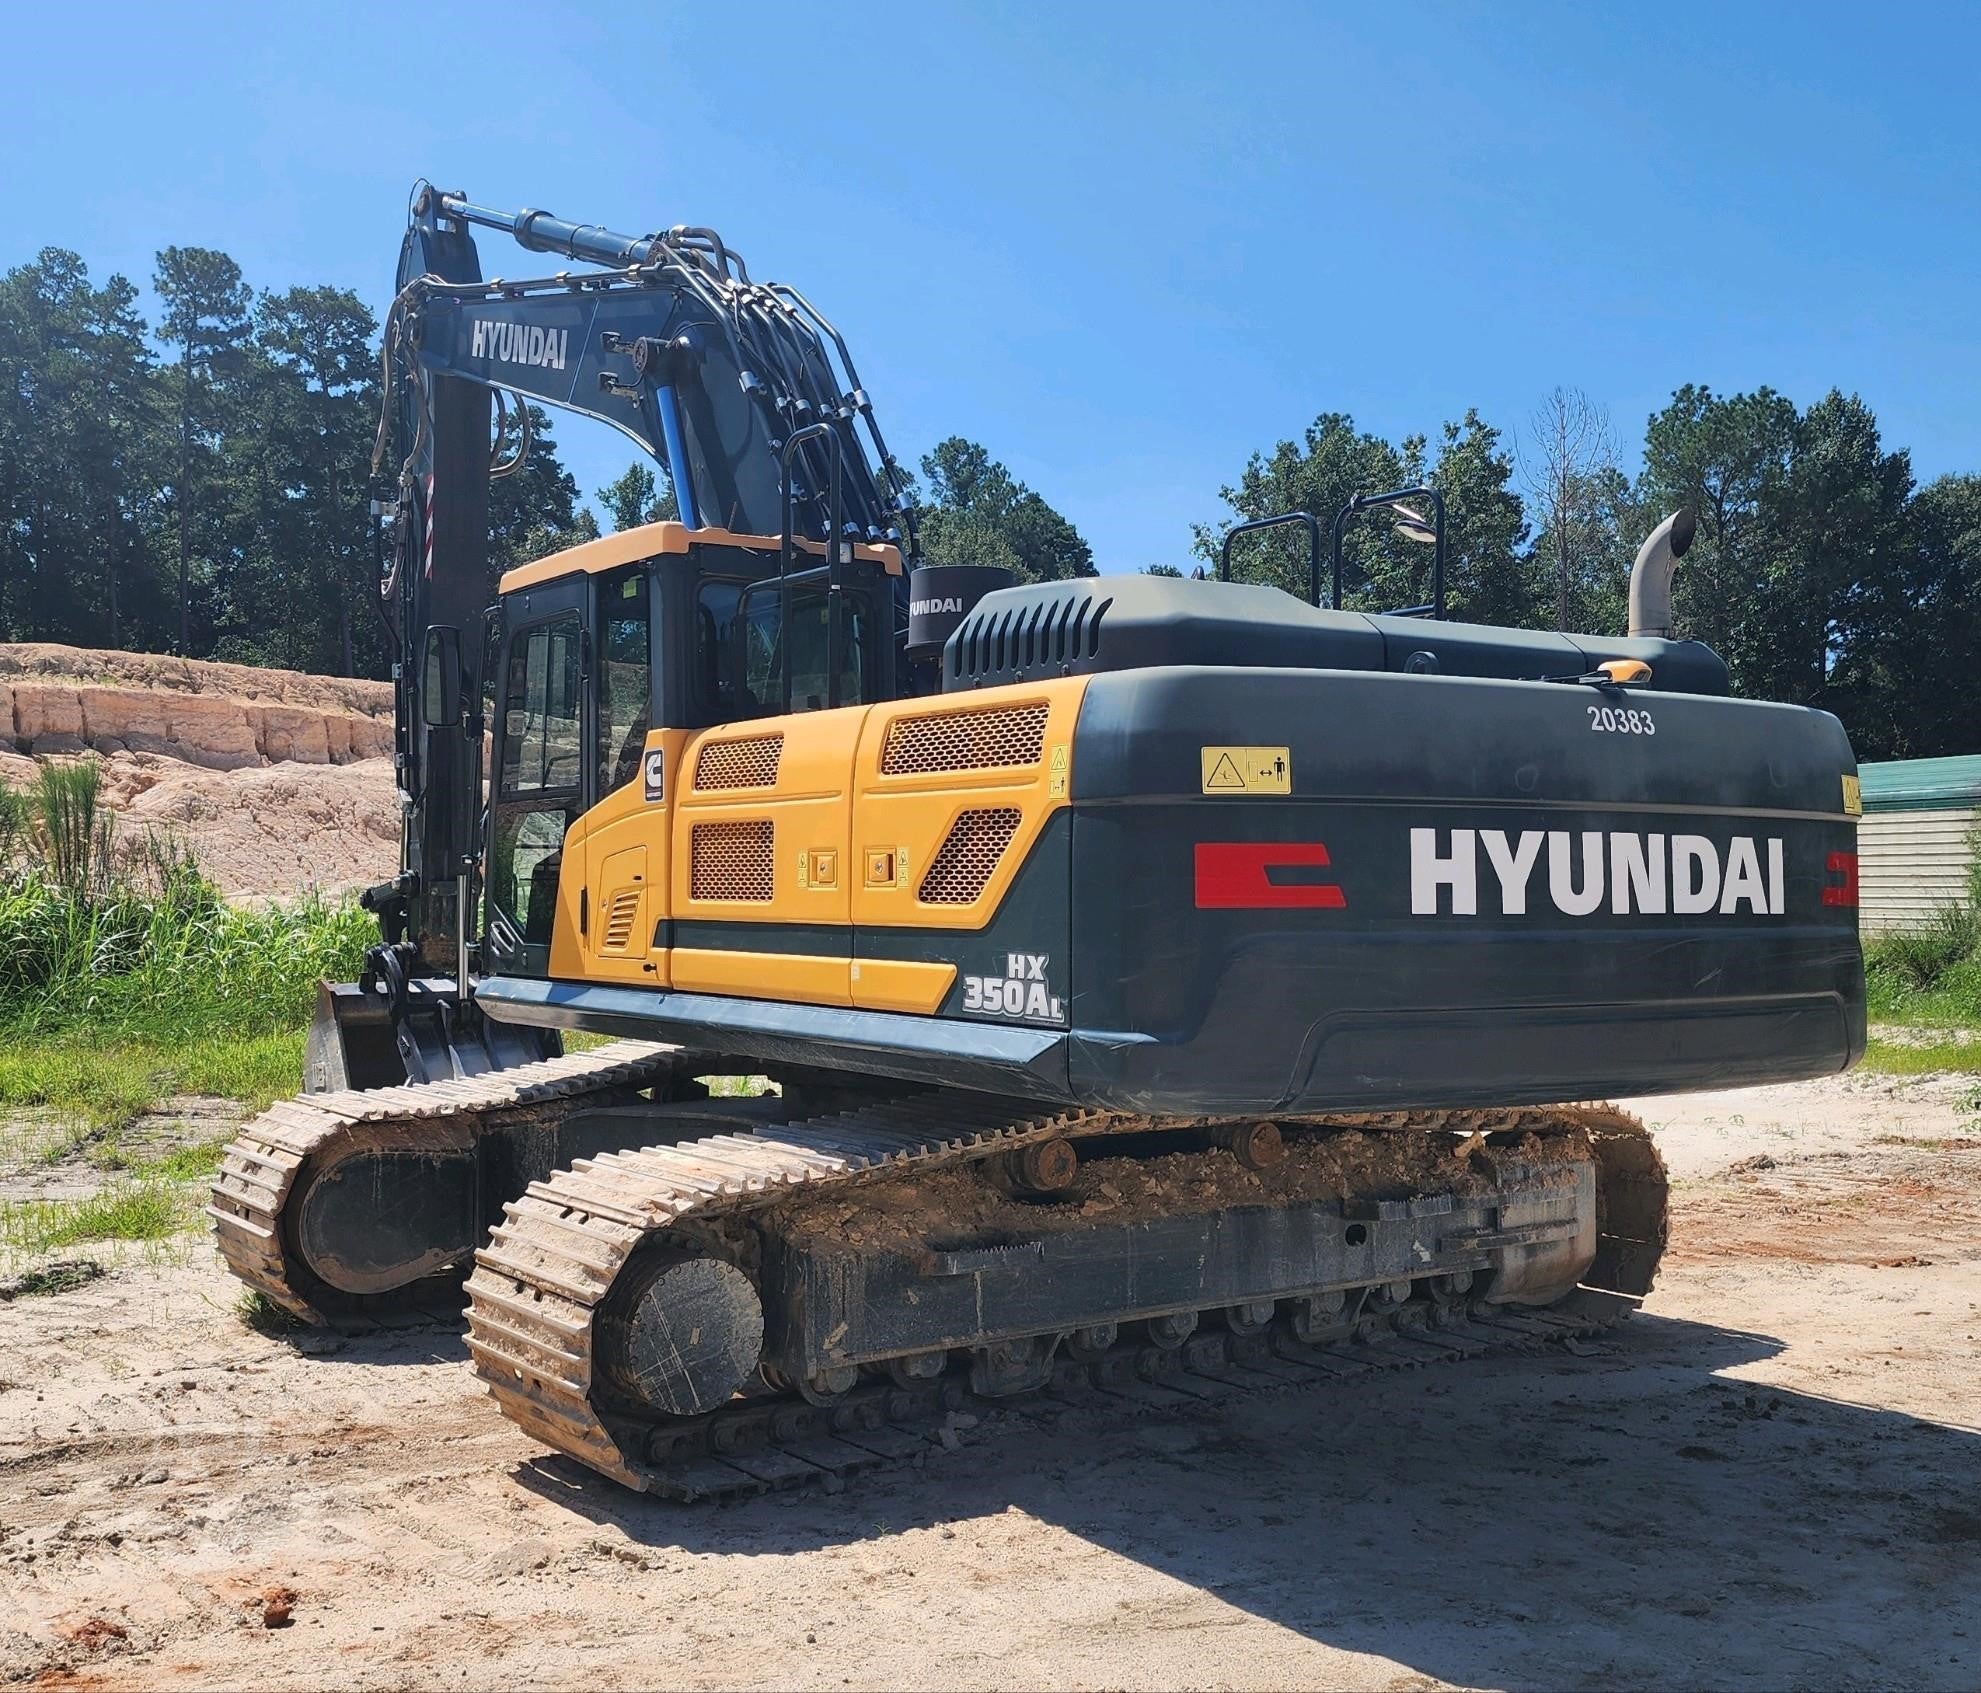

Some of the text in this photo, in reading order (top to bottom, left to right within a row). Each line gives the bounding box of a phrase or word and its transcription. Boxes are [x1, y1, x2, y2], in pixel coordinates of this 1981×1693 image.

[472, 320, 568, 370] HYUNDAI
[910, 598, 962, 617] YUNDAI
[1587, 706, 1656, 736] 20383
[1410, 827, 1785, 916] HYUNDAI
[1008, 953, 1047, 981] HX
